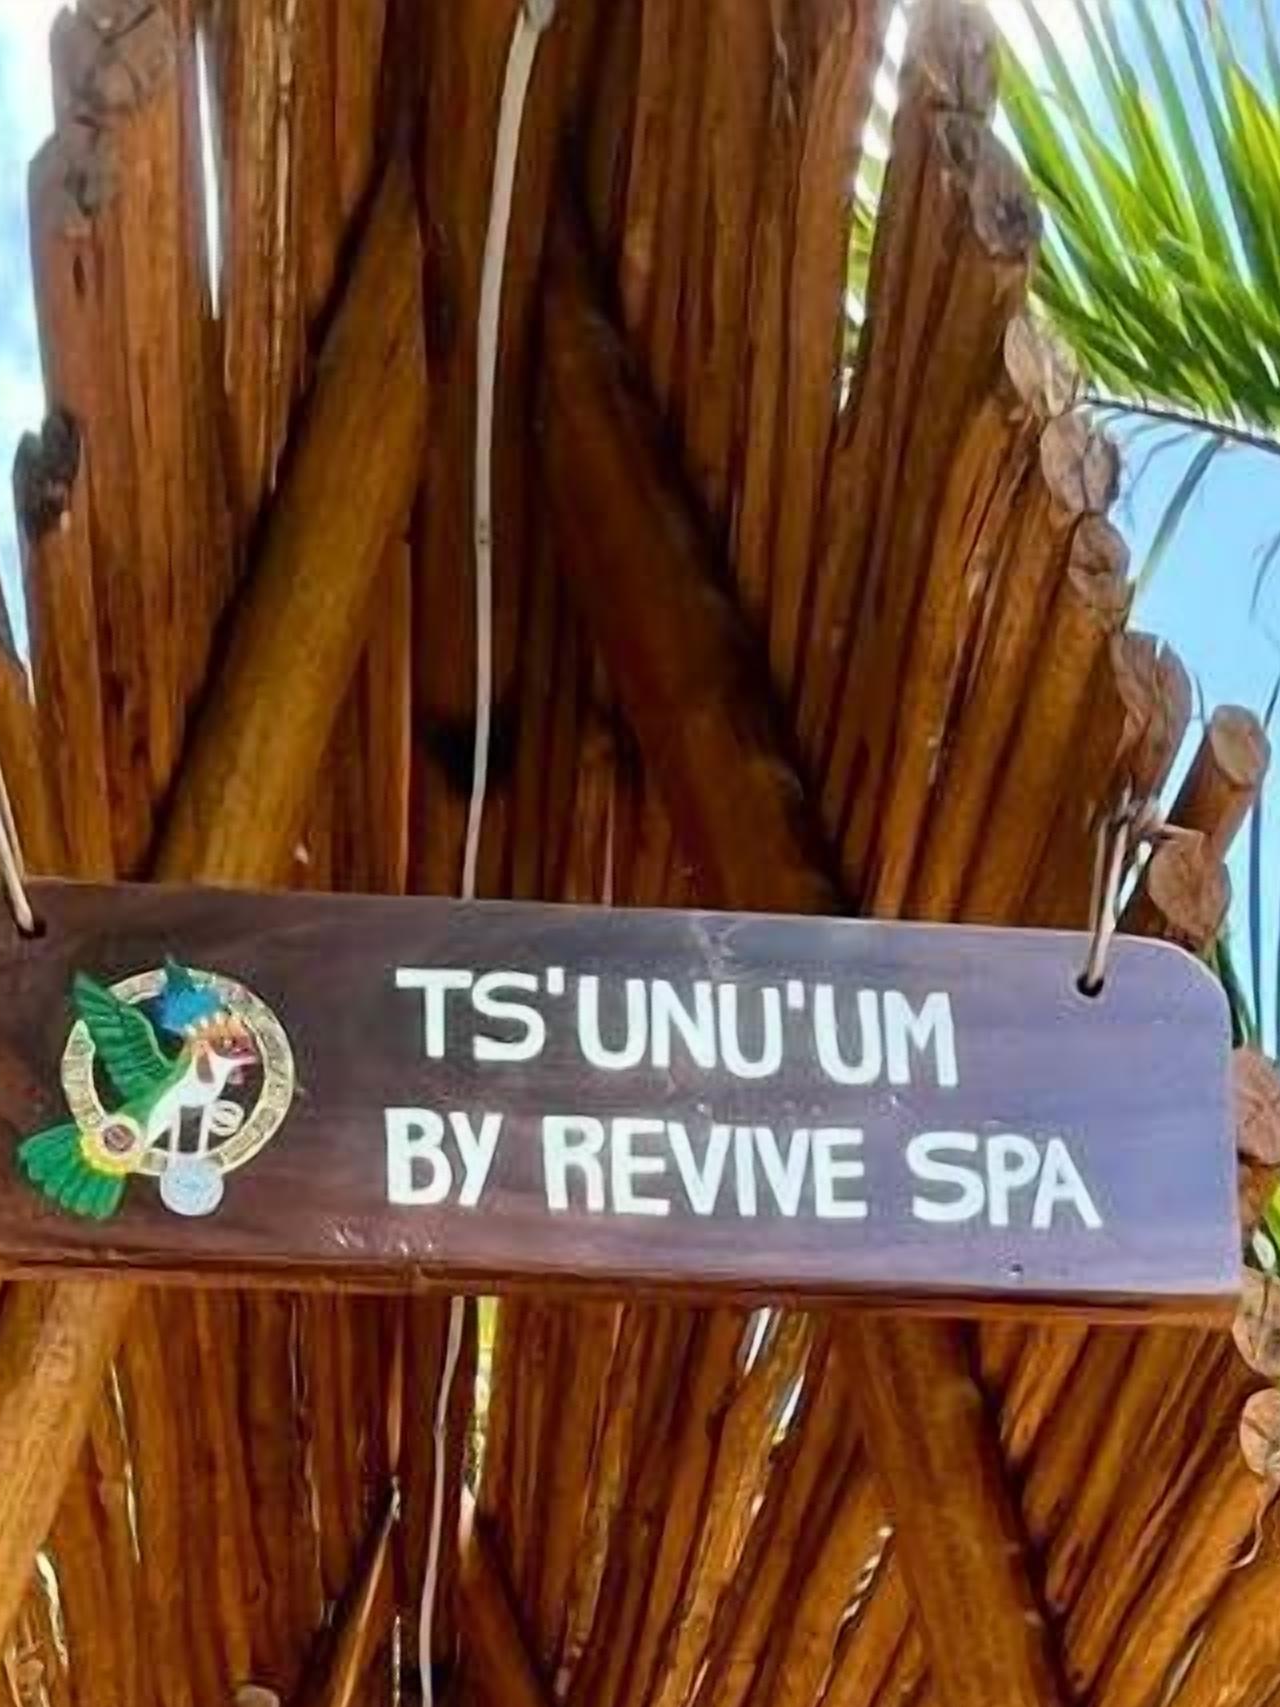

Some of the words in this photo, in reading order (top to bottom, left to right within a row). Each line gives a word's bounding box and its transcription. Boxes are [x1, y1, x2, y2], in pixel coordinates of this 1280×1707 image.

[394, 965, 959, 1088] TS'UNU'UM
[383, 1106, 505, 1209] BY
[540, 1114, 869, 1221] REVIVE
[903, 1129, 1105, 1231] SPA
